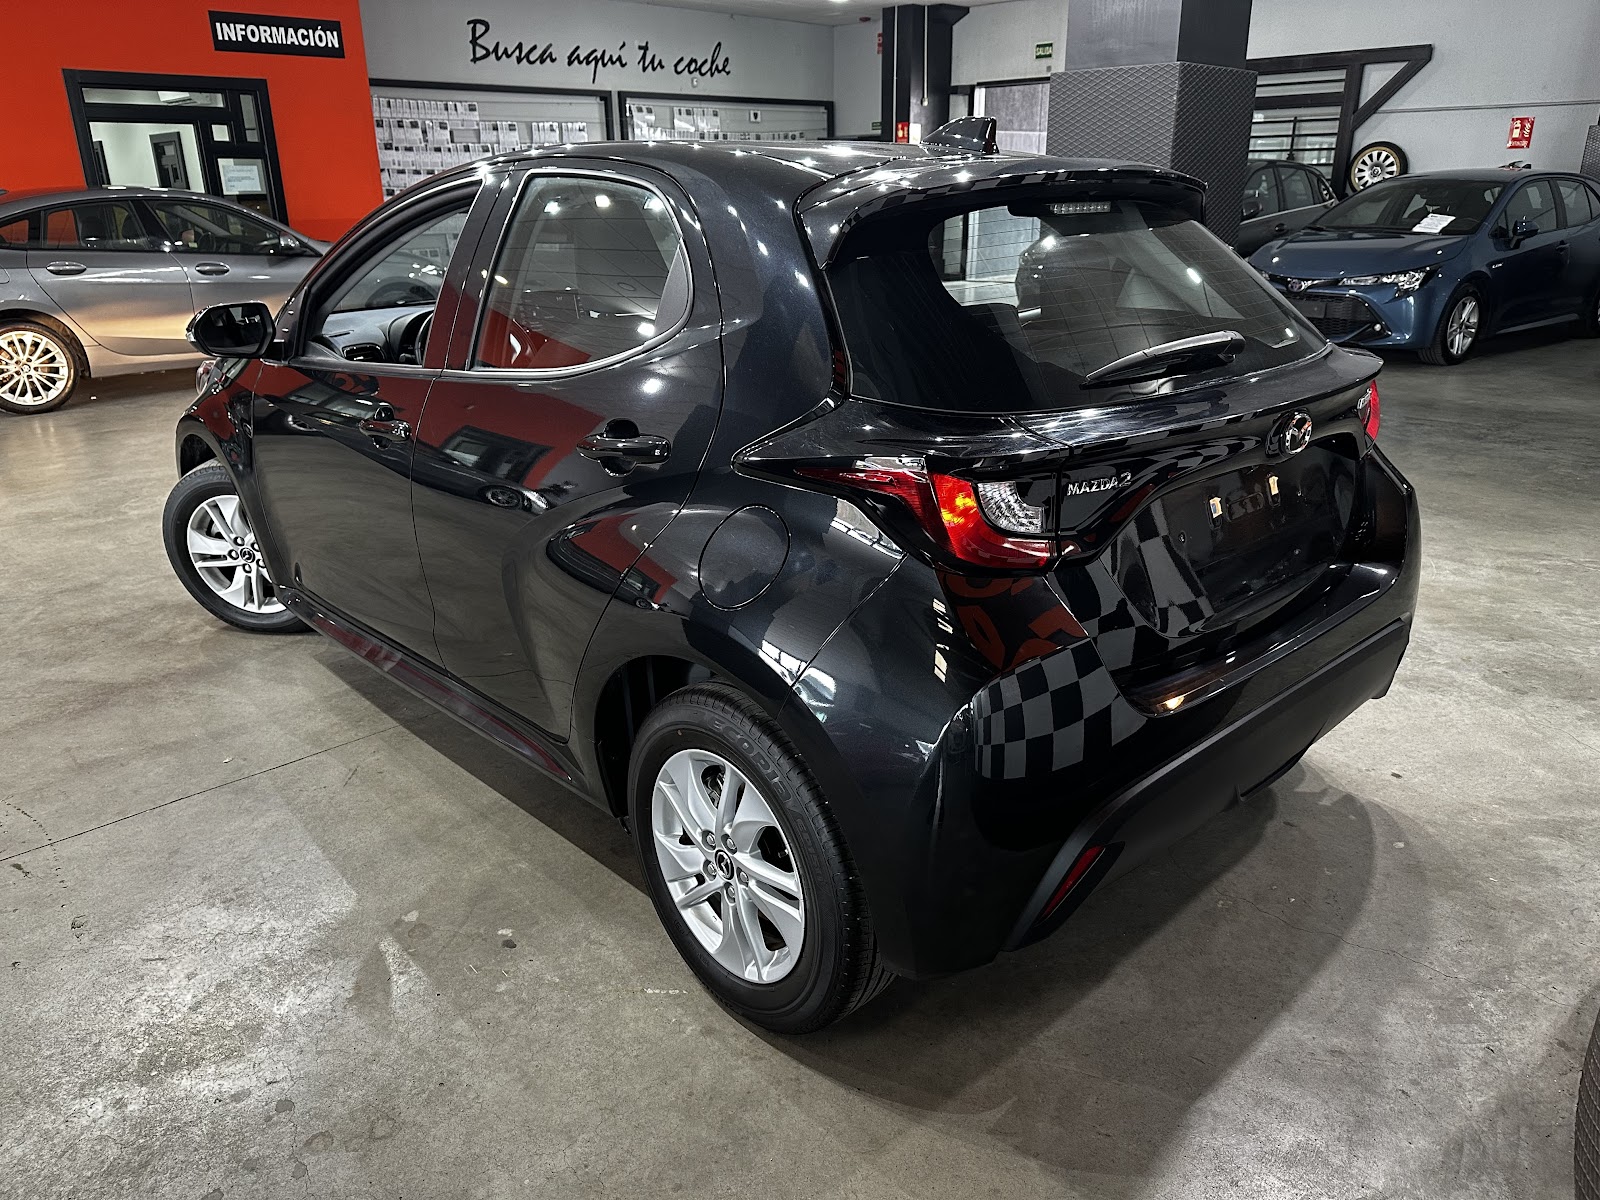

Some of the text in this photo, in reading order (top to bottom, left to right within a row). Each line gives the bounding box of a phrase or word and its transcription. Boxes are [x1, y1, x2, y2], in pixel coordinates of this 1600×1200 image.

[215, 22, 340, 48] INFORMACIÓN
[466, 18, 731, 84] Busca aquí tu coche
[710, 717, 794, 803] ECOPIA
